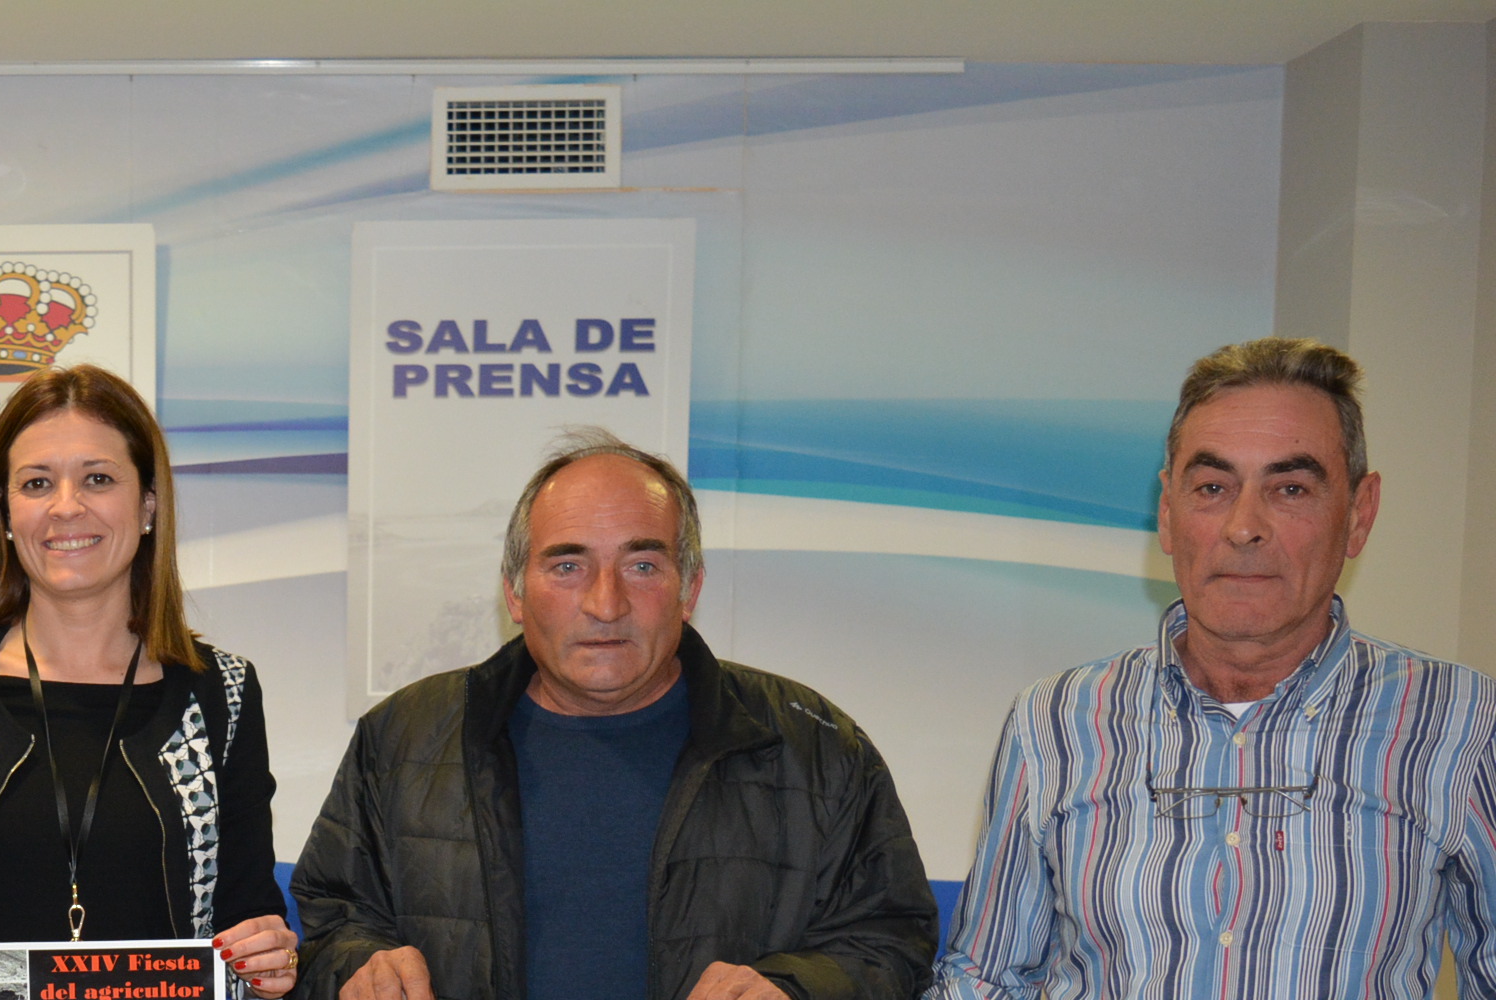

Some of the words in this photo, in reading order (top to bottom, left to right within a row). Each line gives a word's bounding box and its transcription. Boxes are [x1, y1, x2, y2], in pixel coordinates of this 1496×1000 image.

[386, 318, 552, 355] SALA
[574, 318, 656, 353] DE
[392, 362, 650, 398] PRENSA
[51, 953, 120, 972] XXIV
[128, 953, 200, 971] Fiesta
[39, 982, 76, 1000] del
